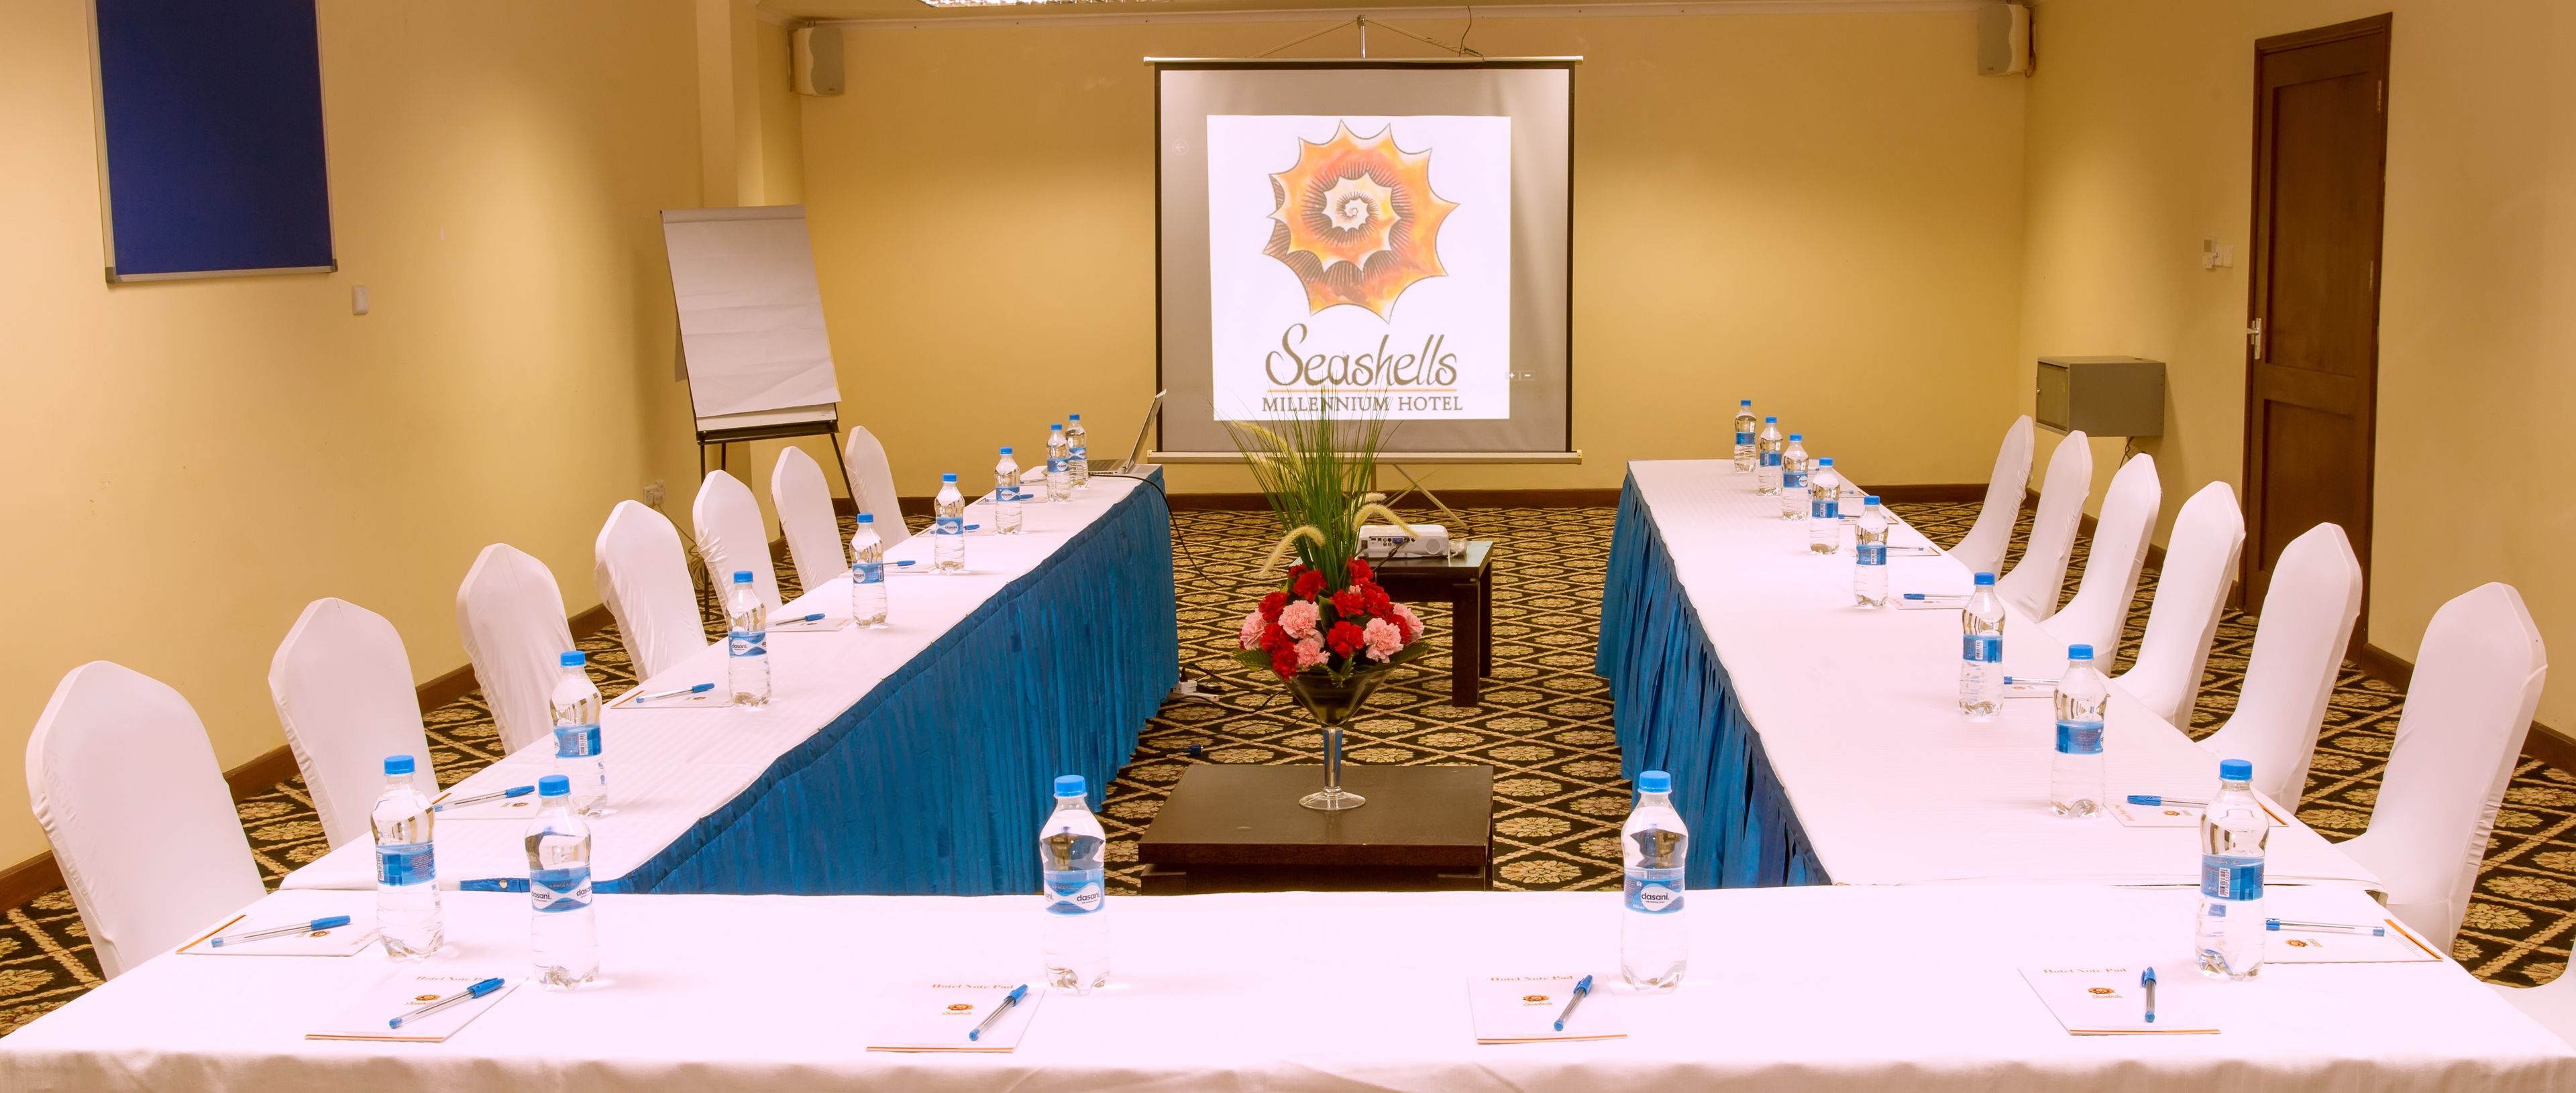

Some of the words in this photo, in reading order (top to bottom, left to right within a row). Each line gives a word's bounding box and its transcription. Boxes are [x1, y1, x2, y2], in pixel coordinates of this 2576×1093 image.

[1265, 323, 1457, 386] Seashells
[1262, 396, 1389, 412] MILLENNIUM
[1398, 396, 1463, 412] HOTEL
[1076, 890, 1100, 901] dasani
[1641, 893, 1668, 901] dasani
